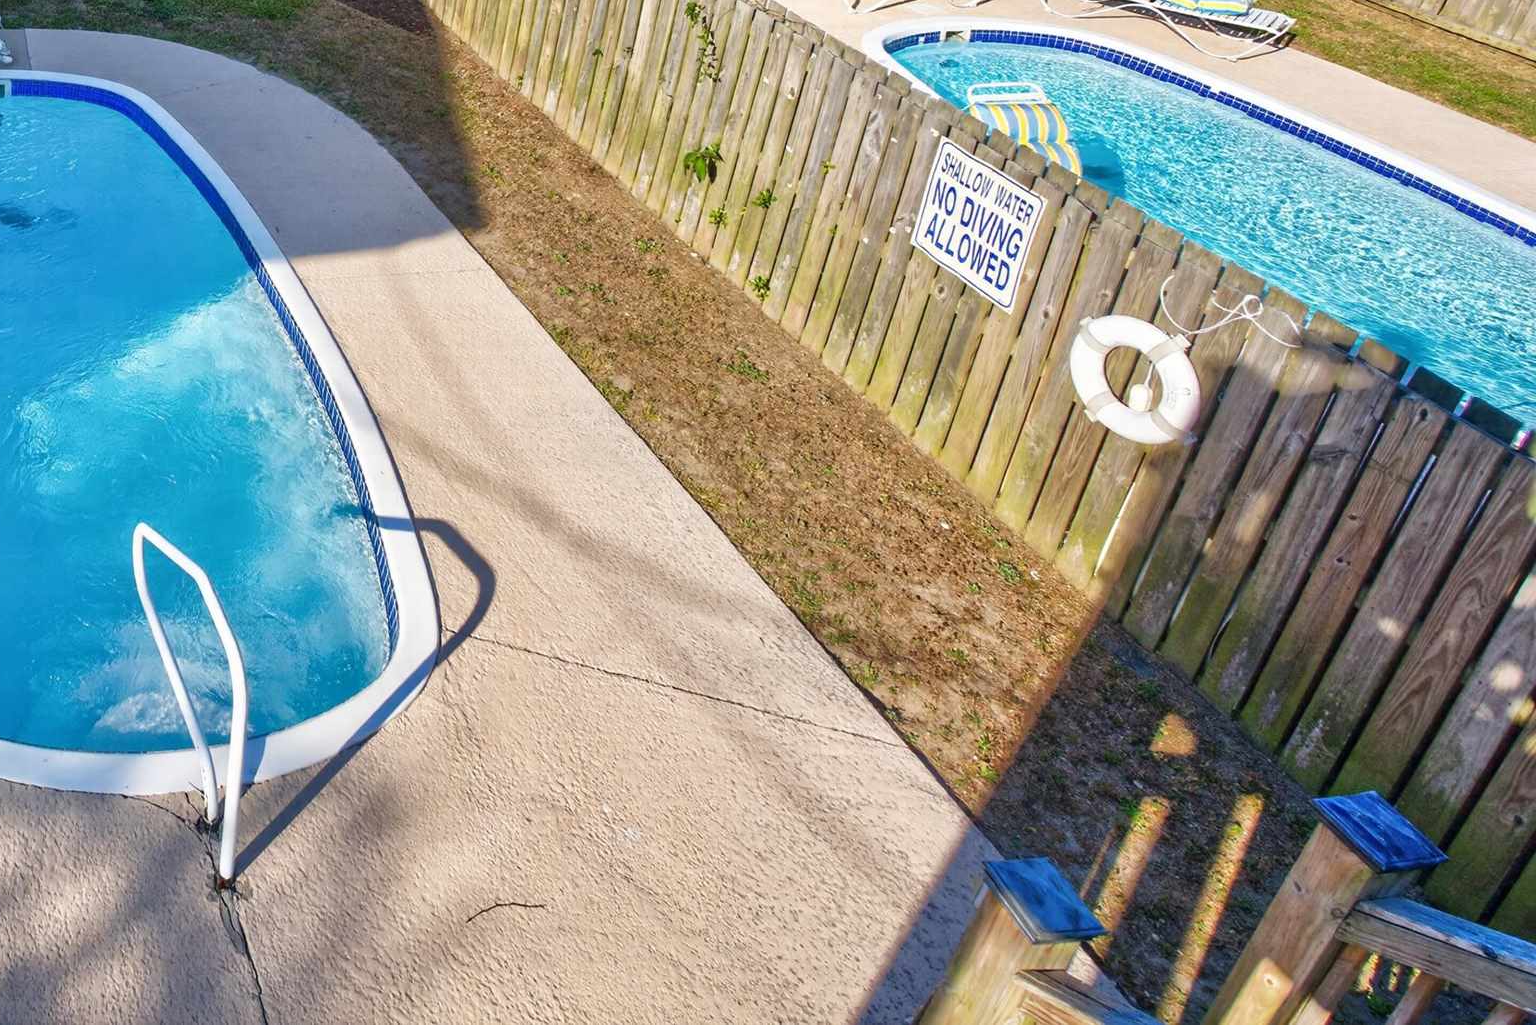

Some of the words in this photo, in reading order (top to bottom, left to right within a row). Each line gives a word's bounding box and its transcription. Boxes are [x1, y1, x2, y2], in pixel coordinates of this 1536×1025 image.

[932, 178, 957, 216] NO
[960, 197, 1024, 261] DIVING
[941, 152, 994, 199] SHALLOW
[994, 184, 1035, 225] WATER
[924, 213, 1010, 291] ALLOWED
